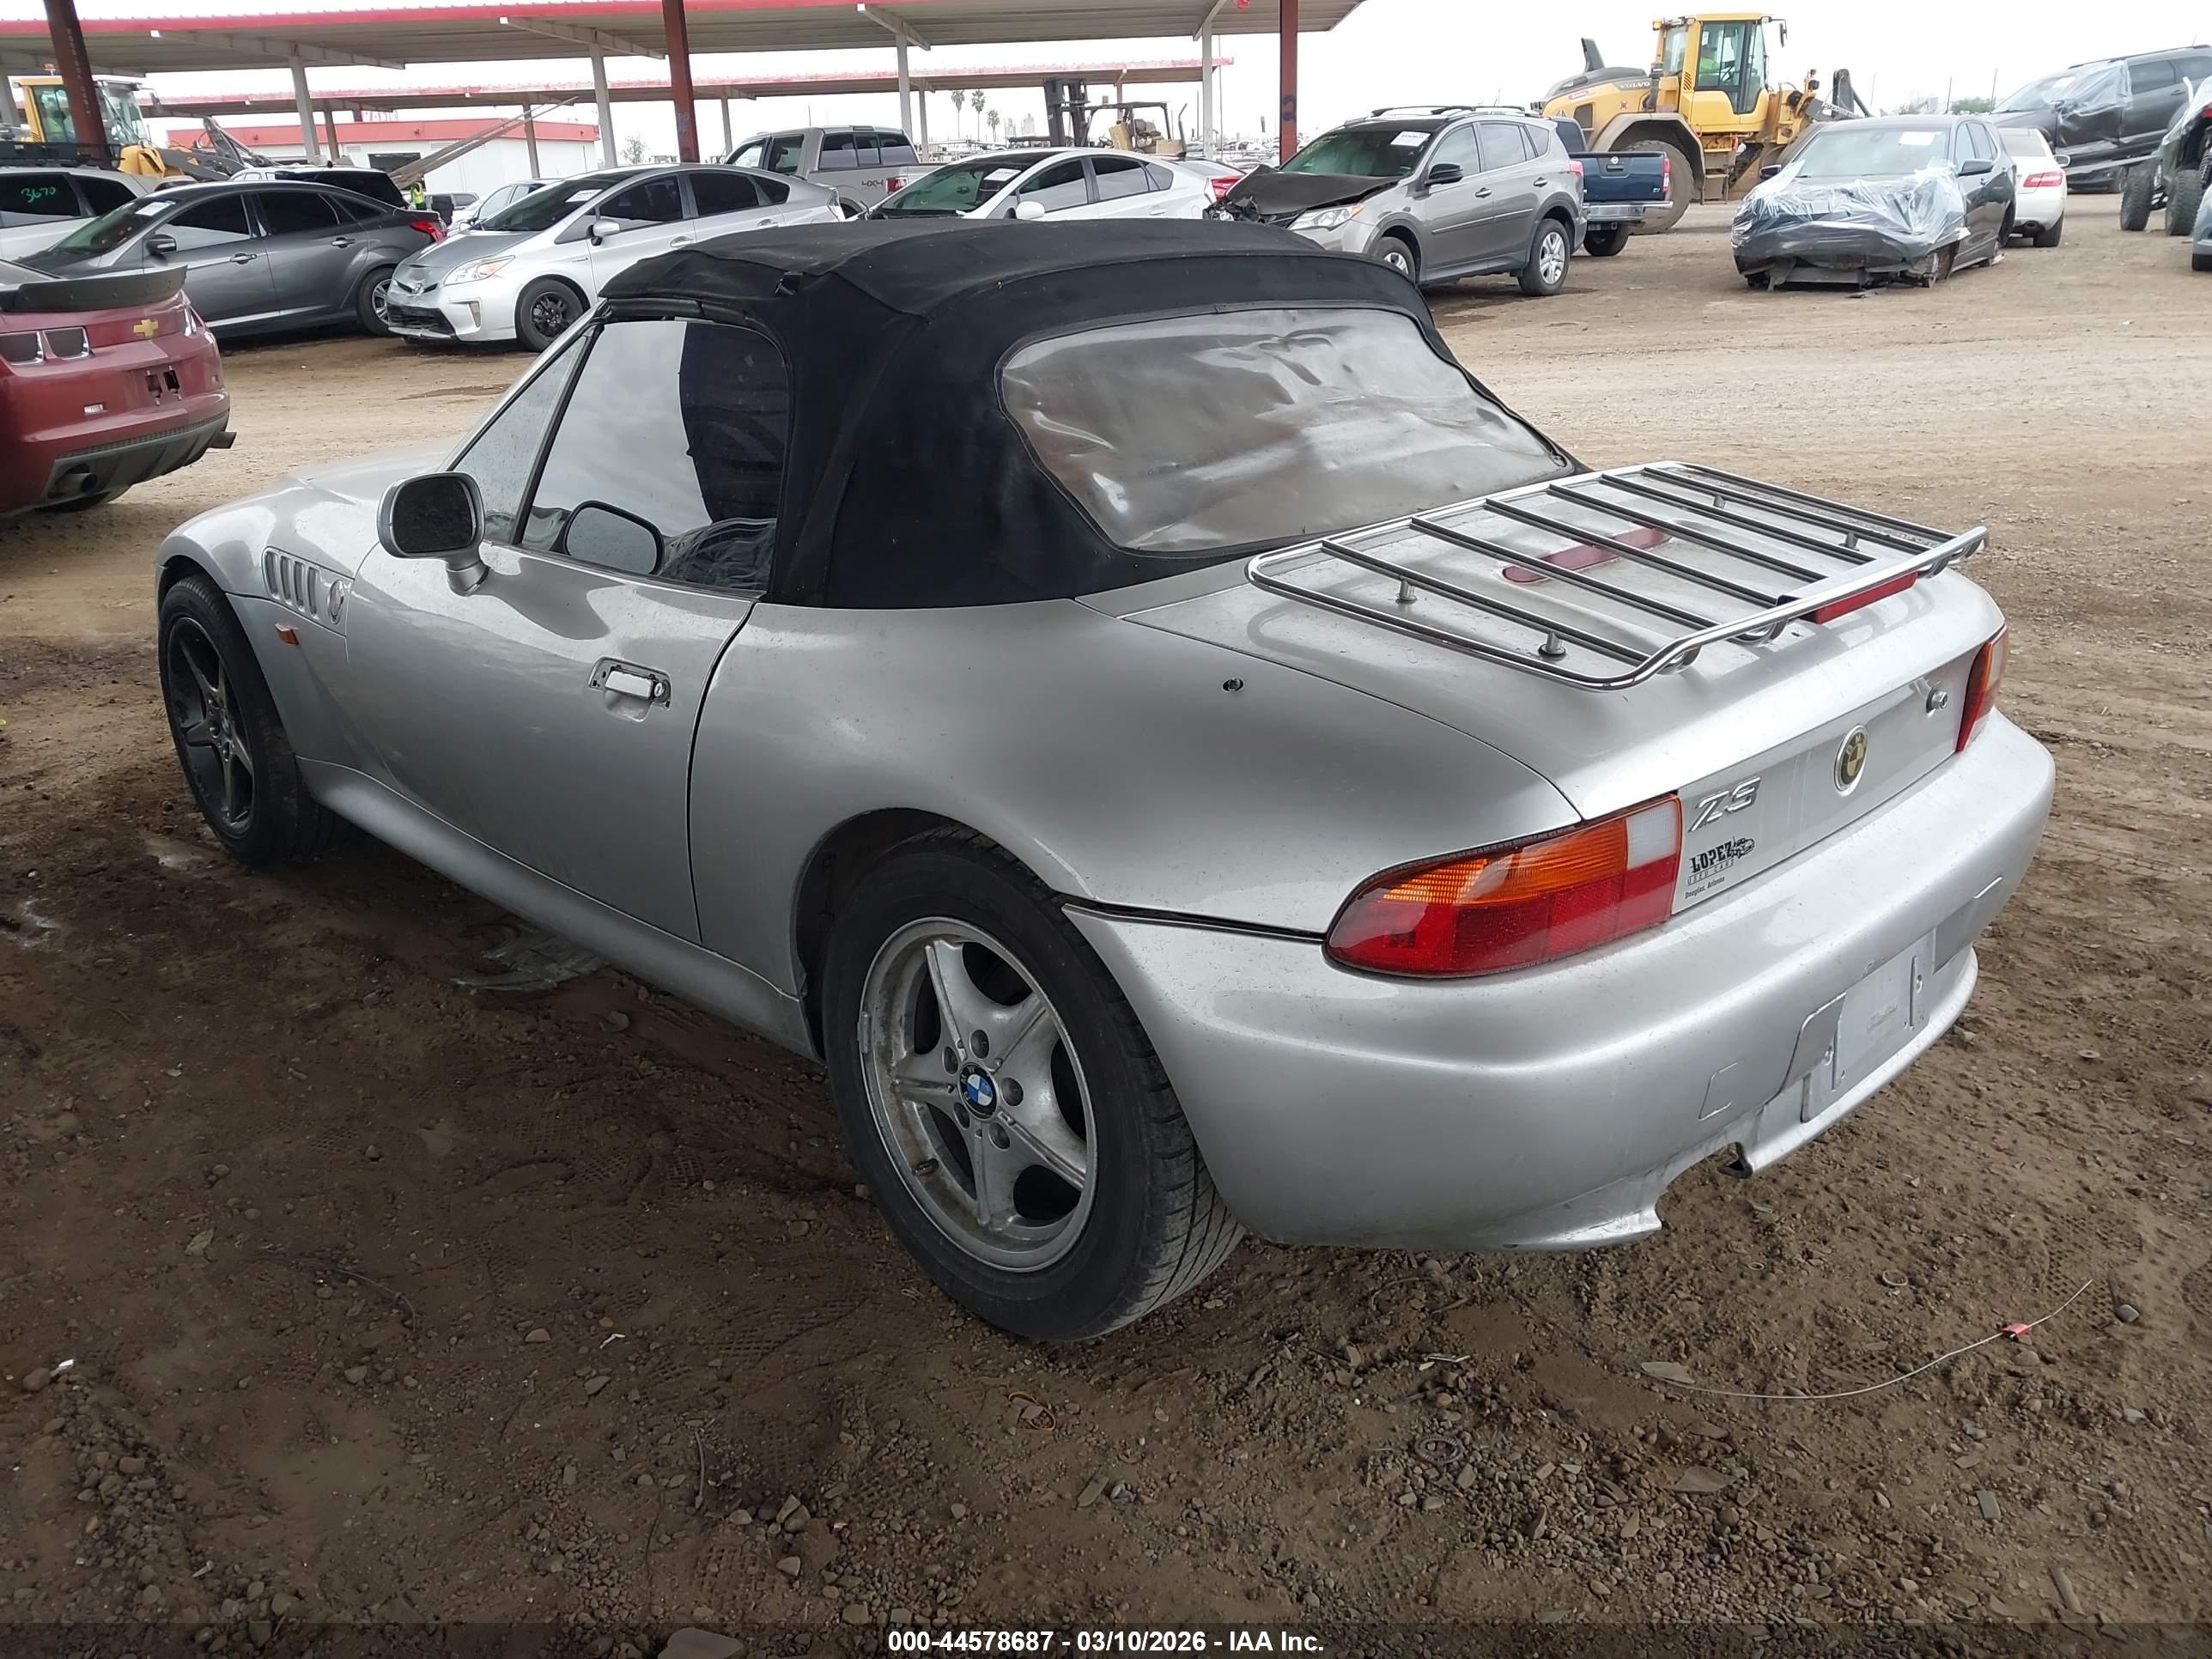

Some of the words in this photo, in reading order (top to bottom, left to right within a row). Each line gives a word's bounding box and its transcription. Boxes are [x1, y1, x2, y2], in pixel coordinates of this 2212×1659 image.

[21, 186, 57, 203] 3670
[1688, 776, 1761, 832] Z3
[1689, 841, 1733, 874] LOPEZ
